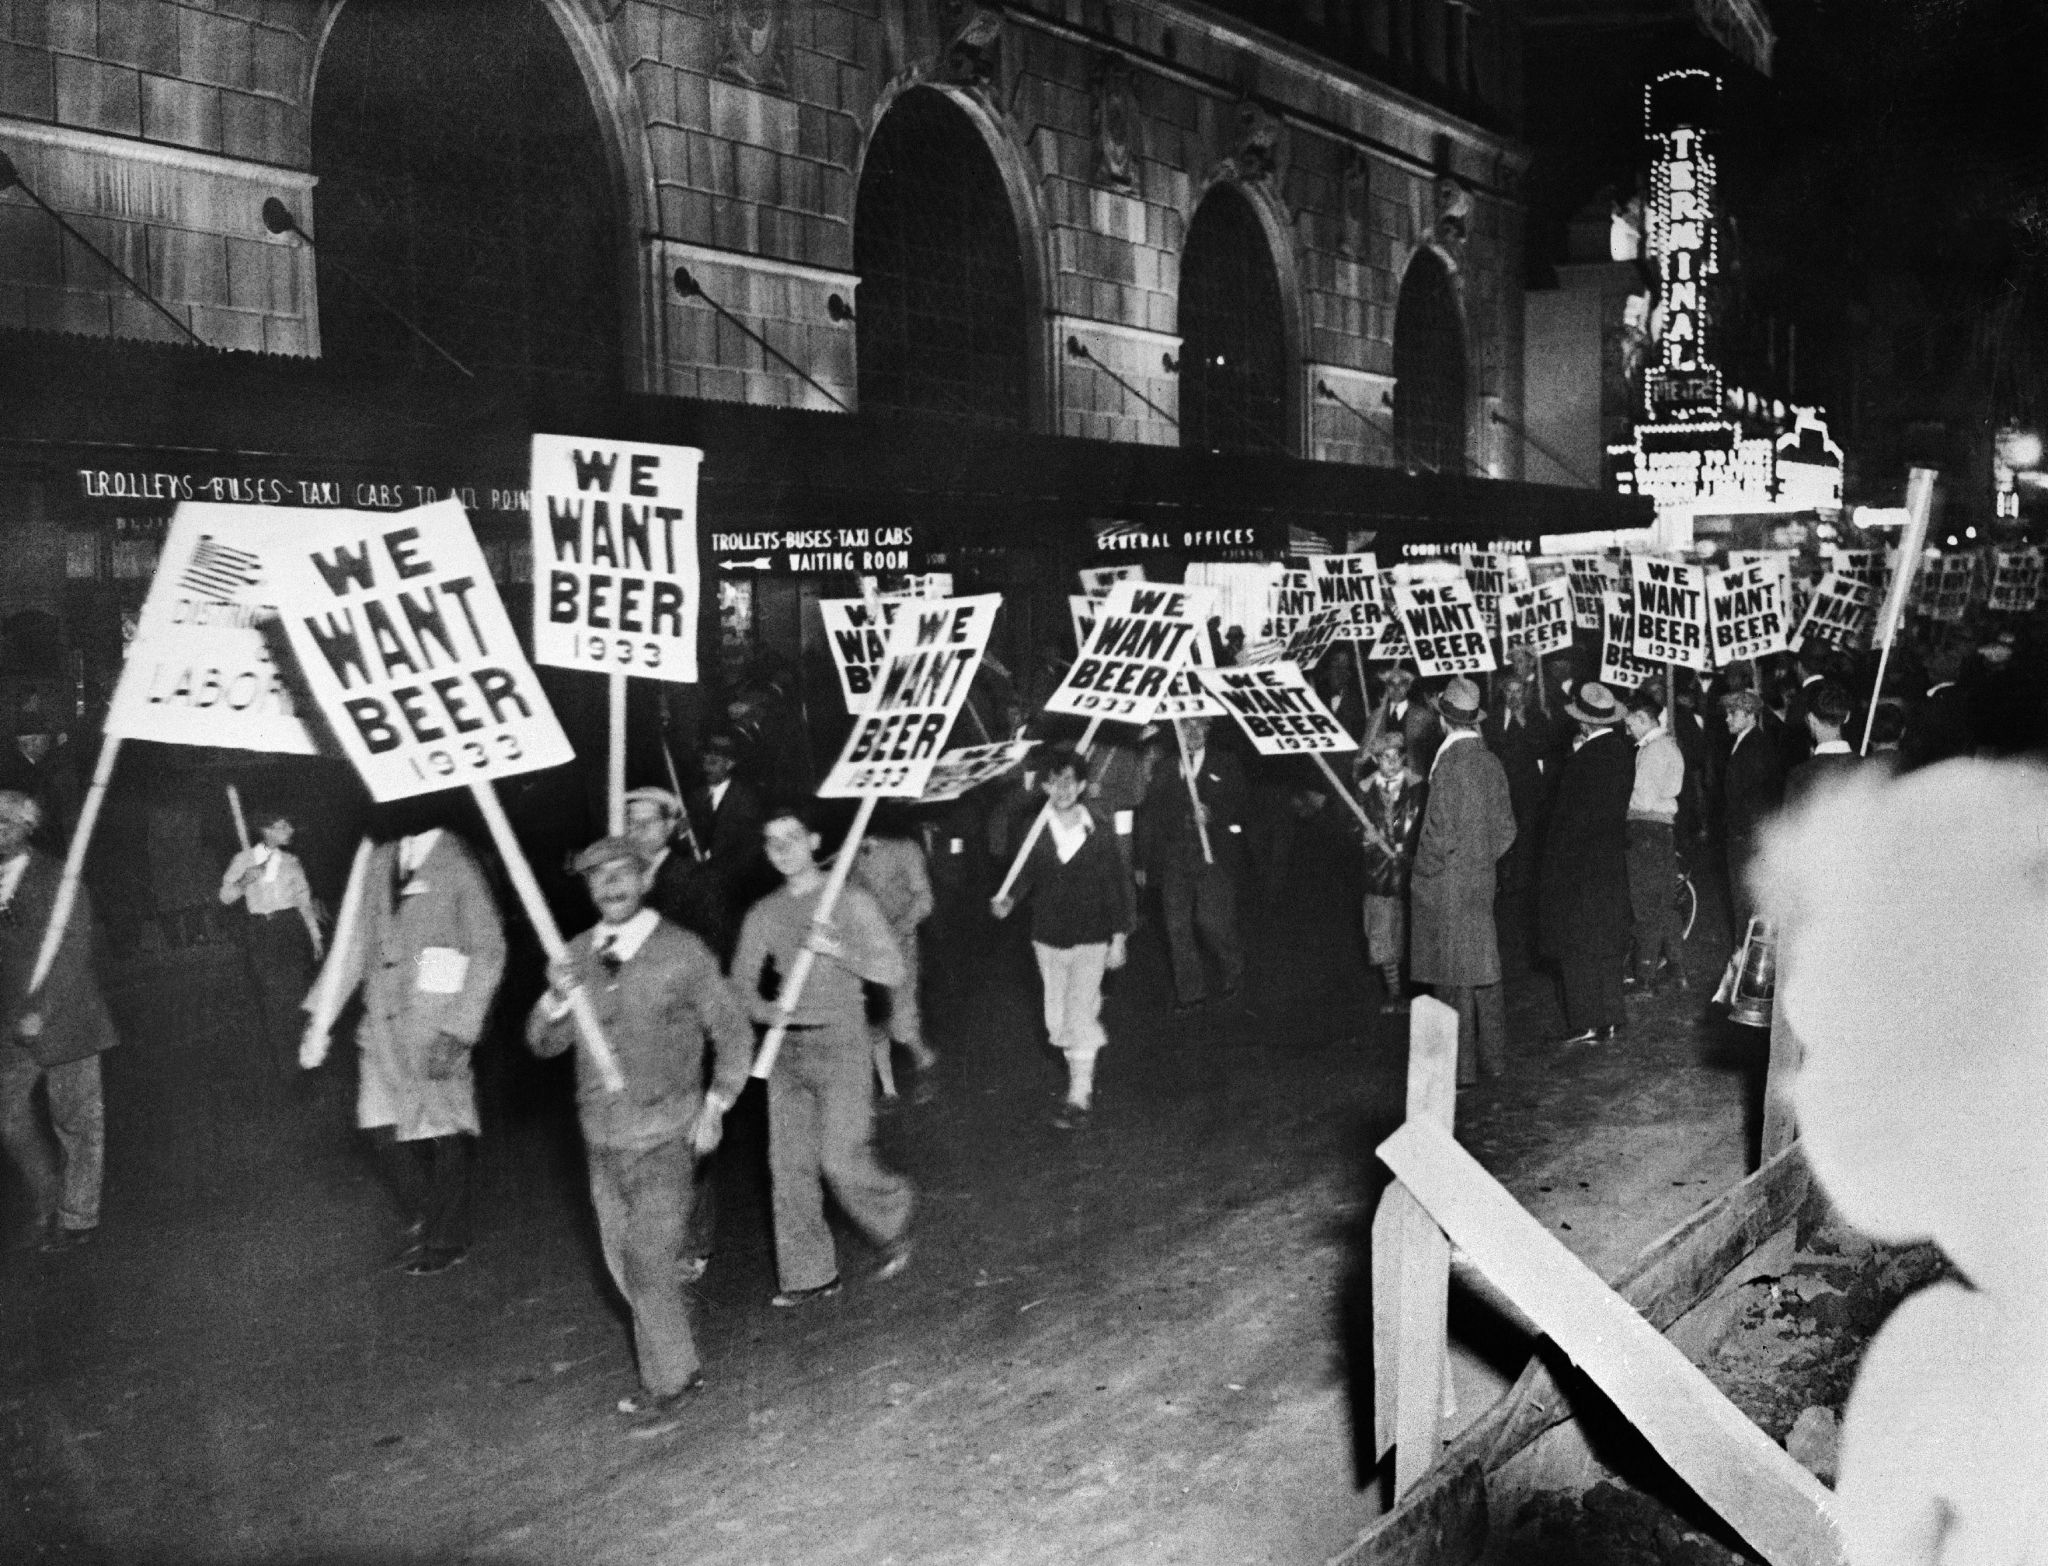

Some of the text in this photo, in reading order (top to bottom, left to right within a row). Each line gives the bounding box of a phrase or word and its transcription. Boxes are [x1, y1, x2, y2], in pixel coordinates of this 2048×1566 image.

[1669, 129, 1704, 371] TERMINAL
[571, 448, 661, 497] WE
[79, 469, 193, 500] TROLLEYS
[299, 480, 341, 505] TAXI
[356, 482, 402, 508] CABS
[547, 495, 683, 574] WANT
[874, 526, 914, 547] CABS
[1096, 529, 1255, 551] GENERAL OFFICES
[309, 526, 436, 597] WE
[788, 550, 856, 572] WAITING
[862, 550, 910, 570] ROOM
[1325, 558, 1363, 575] WE
[1469, 555, 1496, 569] WE
[1572, 559, 1599, 572] WE
[1647, 562, 1689, 585] WE
[1318, 576, 1375, 603] WANT
[1723, 567, 1763, 591] WE
[549, 569, 684, 637] BEER
[1130, 590, 1186, 617] WE
[1270, 590, 1316, 615] ANT
[1409, 586, 1457, 605] WE
[1514, 588, 1553, 607] WE
[1638, 581, 1700, 620] WANT
[1714, 583, 1775, 622] WANT
[916, 606, 976, 648] WE
[1405, 603, 1475, 637] WANT
[1506, 598, 1563, 631] WANT
[302, 576, 490, 690] WANT
[1092, 616, 1194, 662] WANT
[1638, 613, 1700, 649] BEER
[1717, 612, 1780, 648] BEER
[574, 633, 661, 668] 1933
[1414, 632, 1487, 661] BEER
[1649, 643, 1690, 661] 1933
[1731, 639, 1772, 658] 1933
[1066, 658, 1170, 698] BEER
[1435, 657, 1481, 671] 1933
[877, 648, 977, 711] WANT
[1221, 671, 1285, 689] WE
[343, 667, 533, 755] BEER
[1072, 693, 1138, 714] 1933
[1221, 687, 1316, 715] WANT
[848, 713, 947, 763] BEER
[1243, 714, 1340, 738] BEER
[1275, 736, 1336, 750] 1933
[408, 734, 523, 782] 1933
